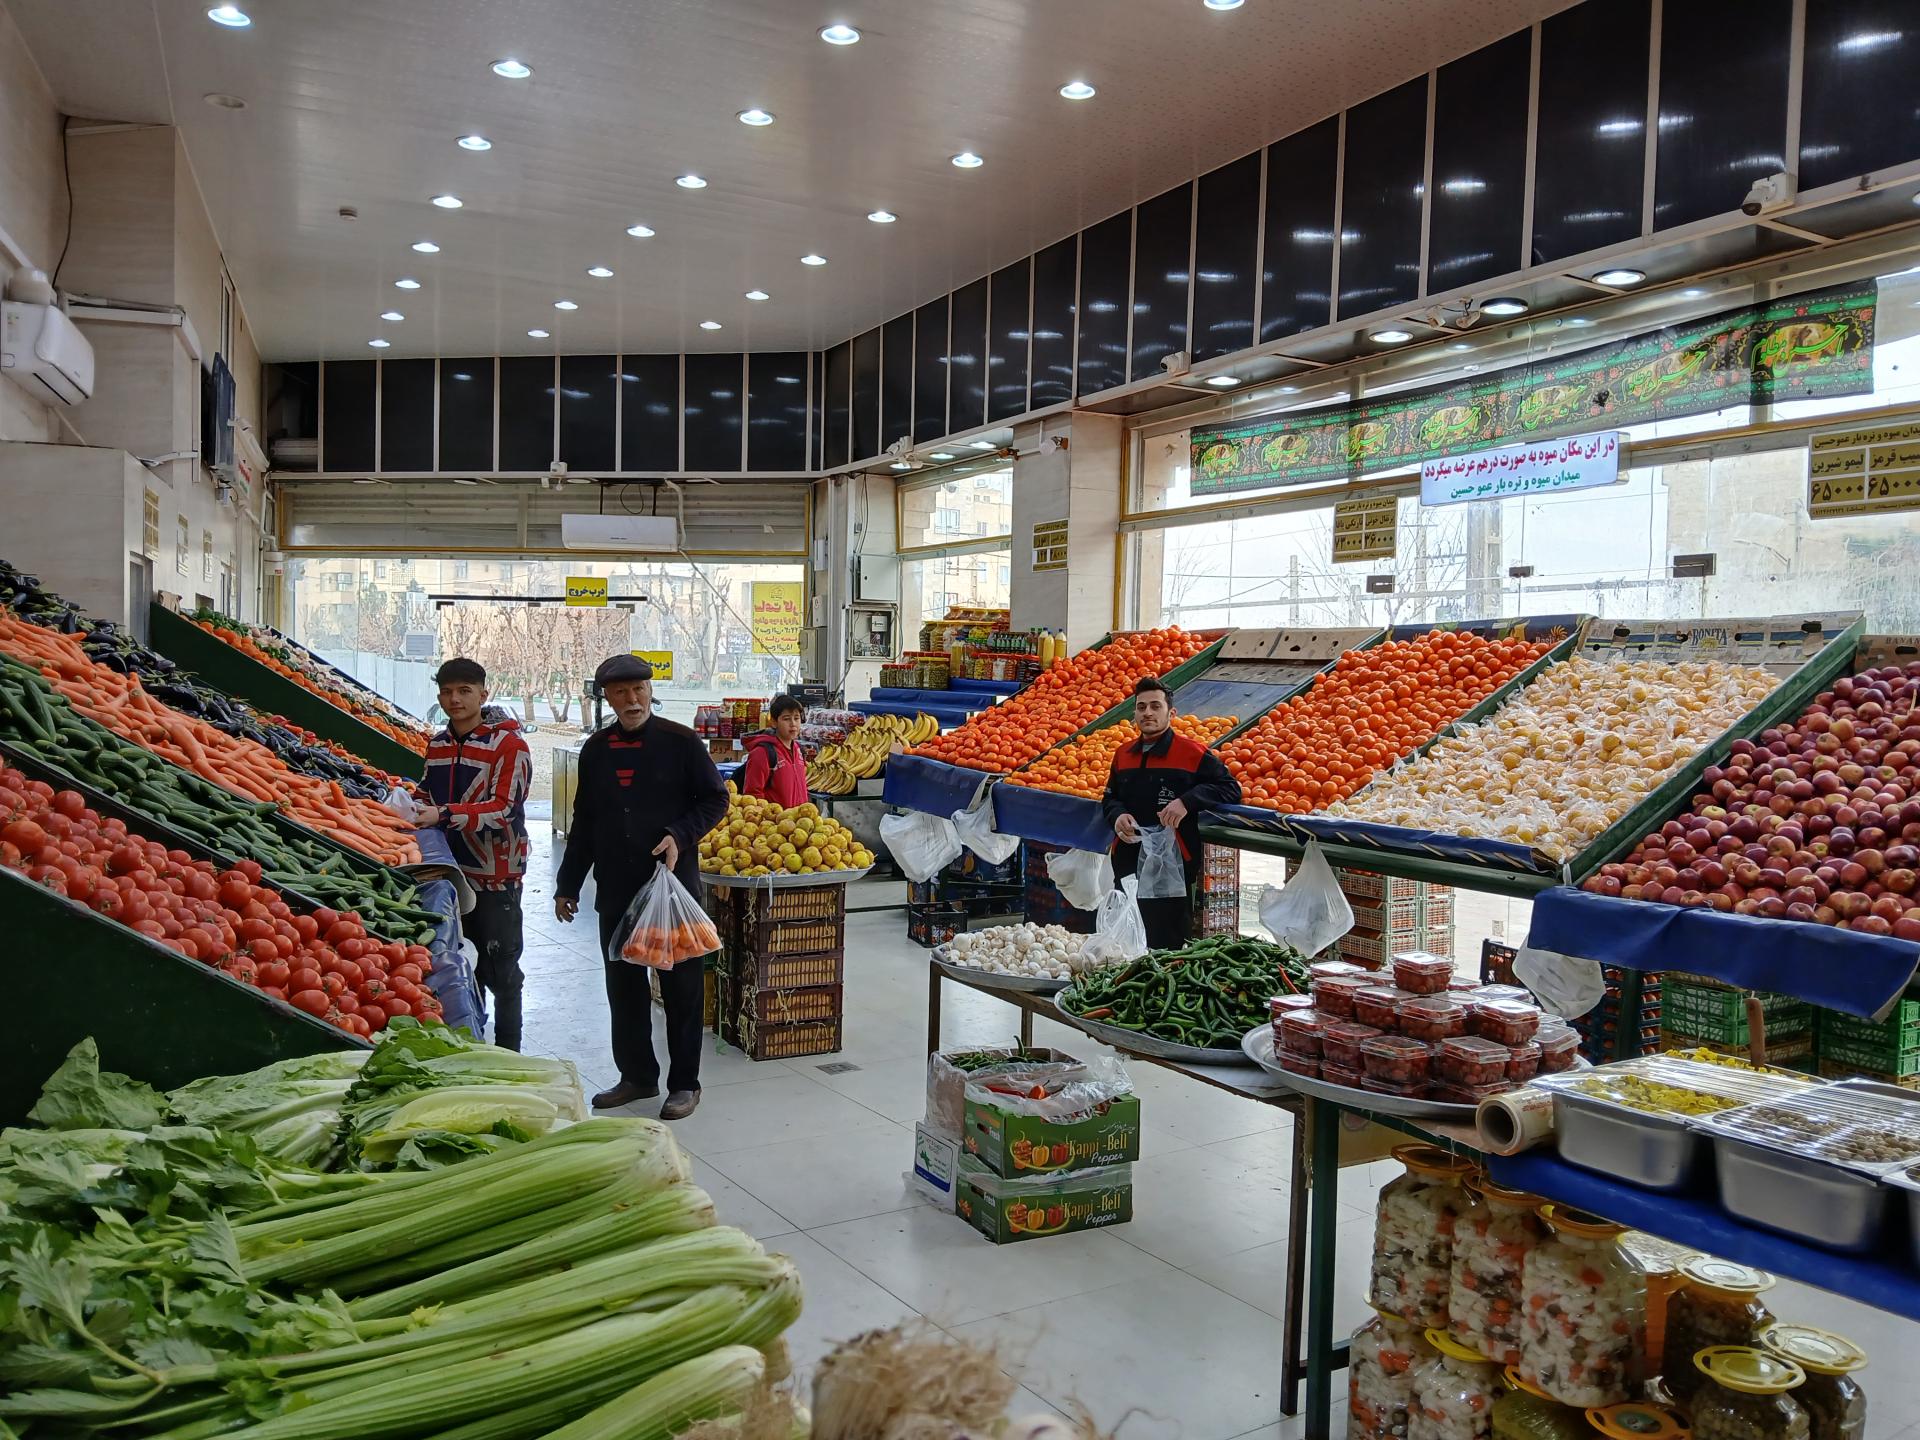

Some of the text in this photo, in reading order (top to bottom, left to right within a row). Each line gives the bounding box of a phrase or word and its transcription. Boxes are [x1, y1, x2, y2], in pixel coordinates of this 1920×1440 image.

[1877, 434, 1882, 442] و
[1424, 436, 1615, 481] در این مکان میوه به صورت درهم عرضه میگردد
[1812, 454, 1864, 473] لیمو شیرین
[1870, 449, 1896, 468] قرمز
[1451, 469, 1581, 499] میدان میوه و تره بار عمو حسین
[1811, 482, 1864, 502] ۶۵۰۰۰
[568, 586, 605, 598] درب خروج
[1692, 628, 1728, 645] BONITA
[654, 661, 670, 670] درب
[1069, 1138, 1099, 1159] Kappi
[1091, 1152, 1124, 1166] Pepper
[1063, 1201, 1094, 1222] Kappi
[1085, 1212, 1117, 1227] Pepper
